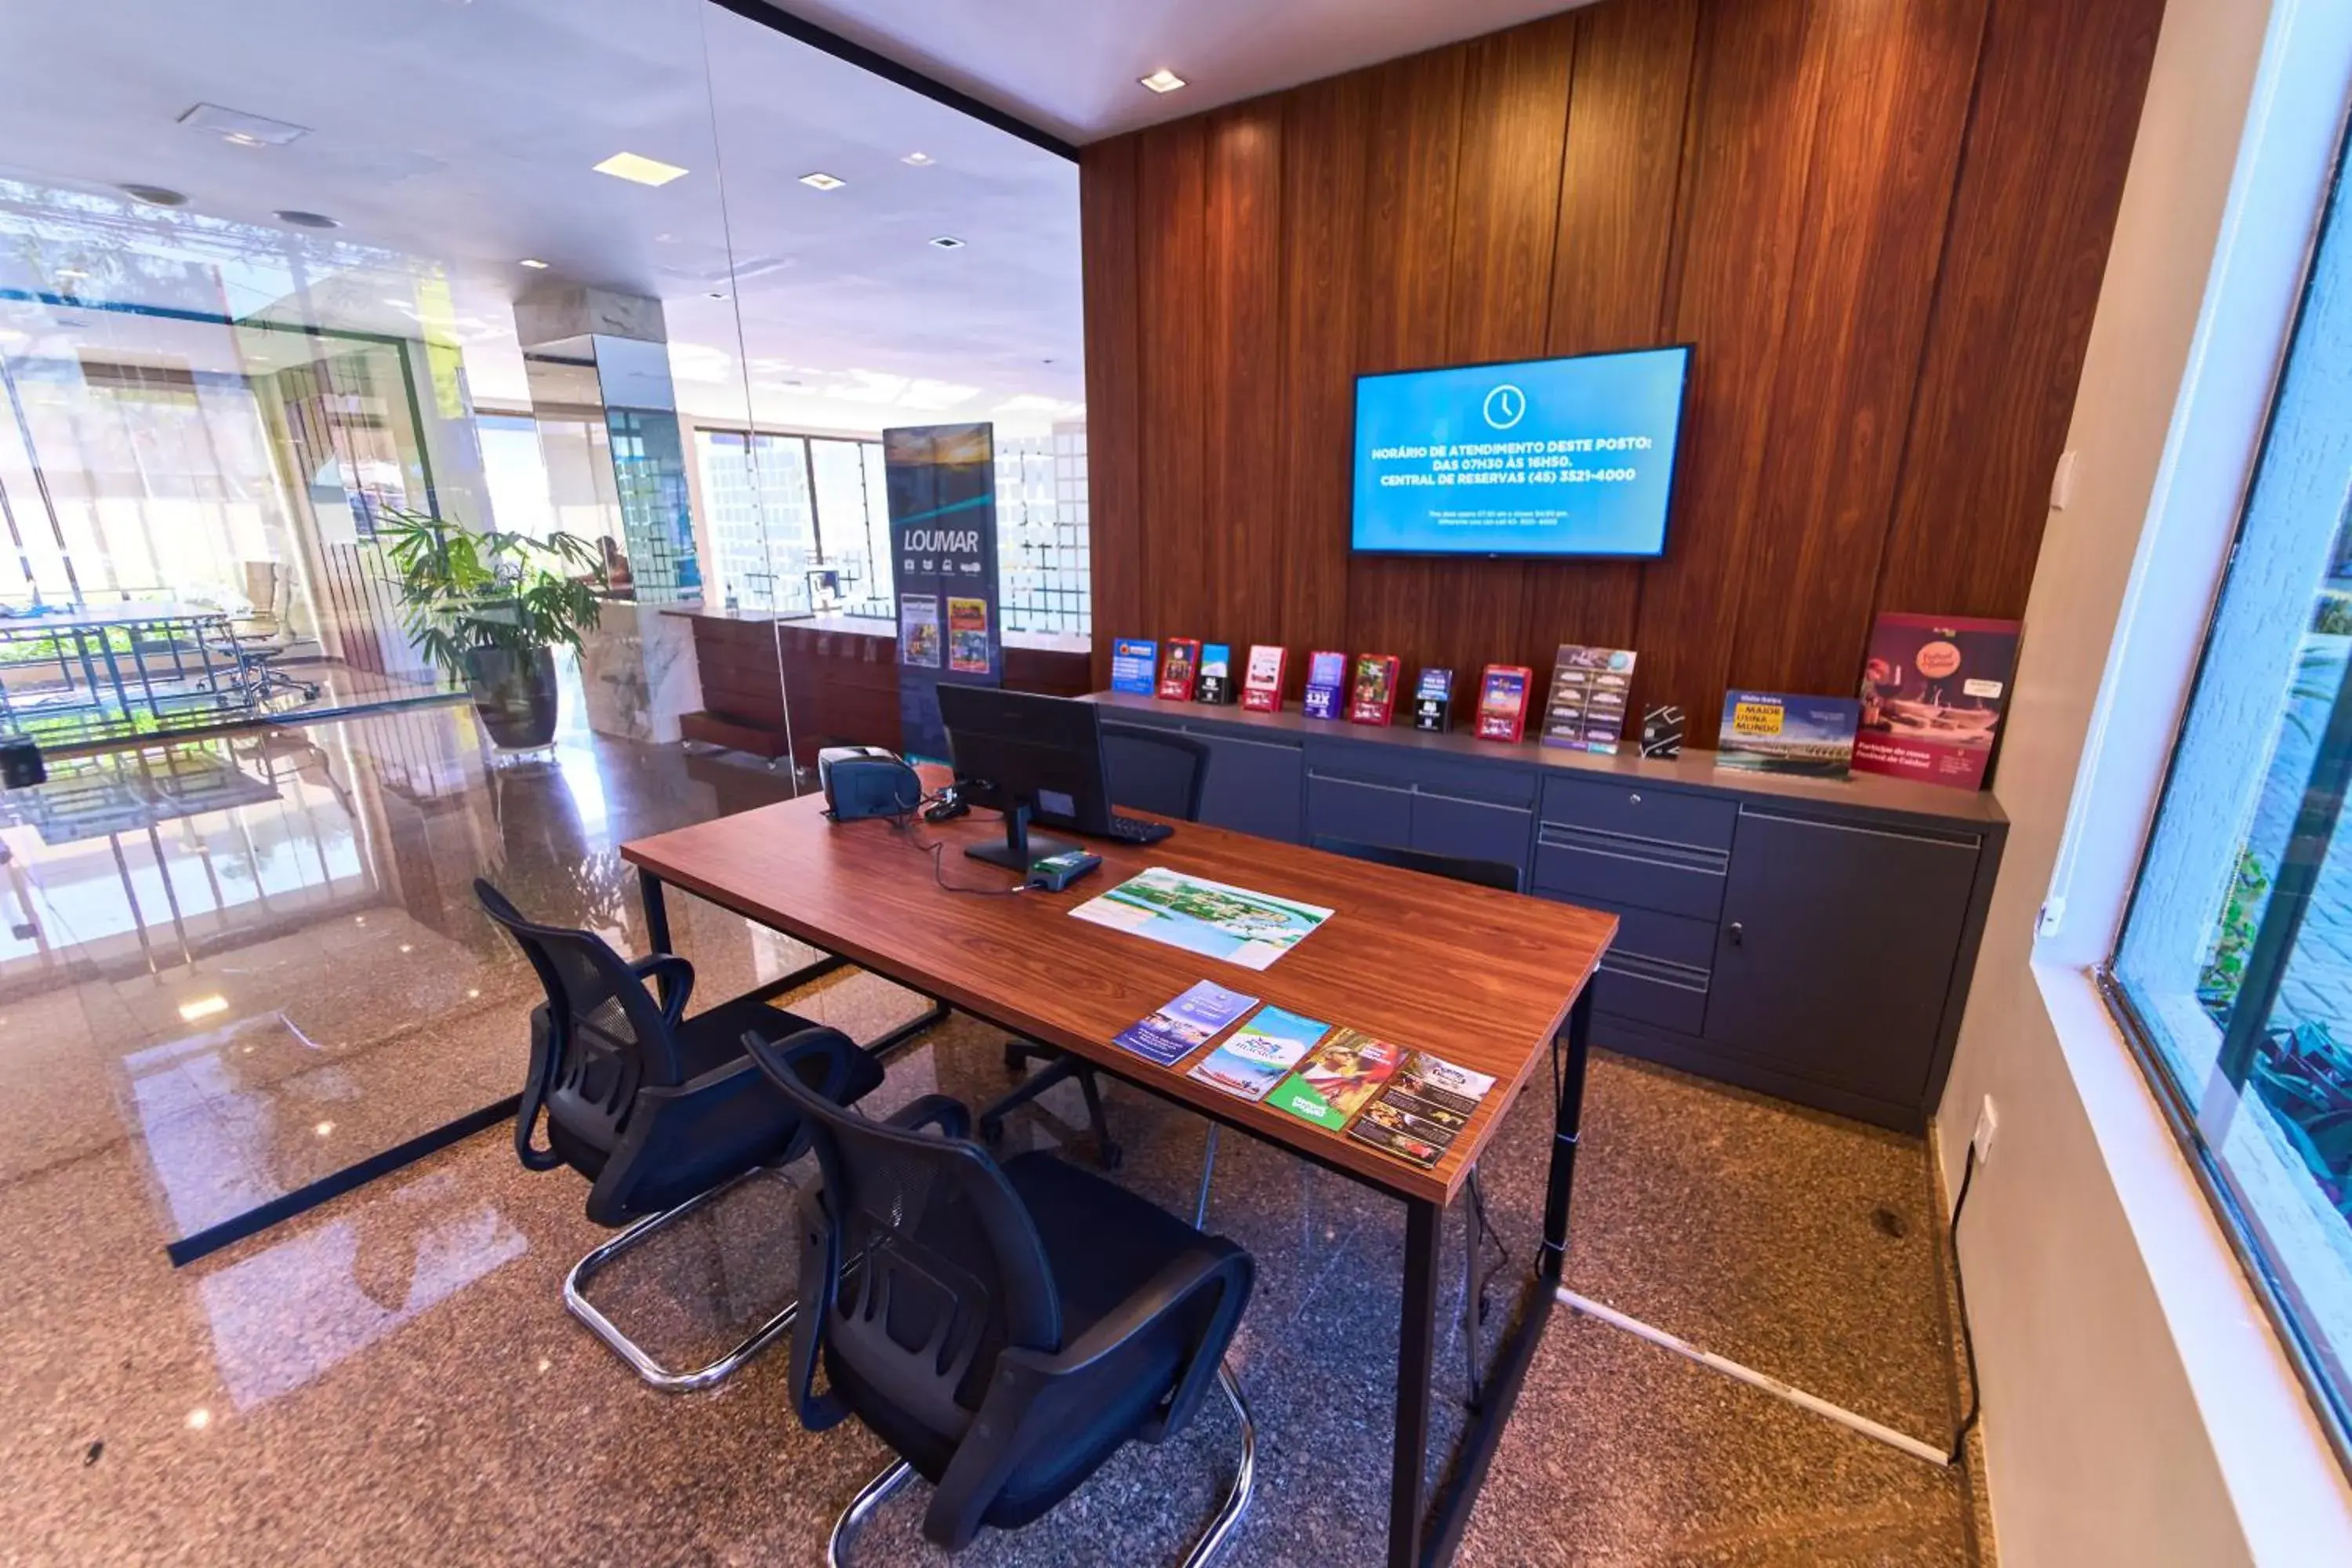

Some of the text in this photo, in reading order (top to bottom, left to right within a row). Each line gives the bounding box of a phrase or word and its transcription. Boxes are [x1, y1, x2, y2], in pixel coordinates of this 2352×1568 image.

[1372, 445, 1428, 460] HORÁRIO
[1429, 445, 1447, 457] DE
[1449, 441, 1544, 456] ATENDIMENTO
[1547, 439, 1593, 453] DESTE
[1432, 459, 1459, 471] DAS
[1461, 458, 1504, 470] 07H30
[1505, 455, 1525, 469] ÀS
[1380, 468, 1636, 486] CENTRAL DE RESERVAS (45) 3521-4000
[904, 529, 978, 553] LOUMAR
[1737, 714, 1767, 723] USINA
[1745, 706, 1780, 715] MAIOR
[1736, 722, 1779, 732] MUNDO
